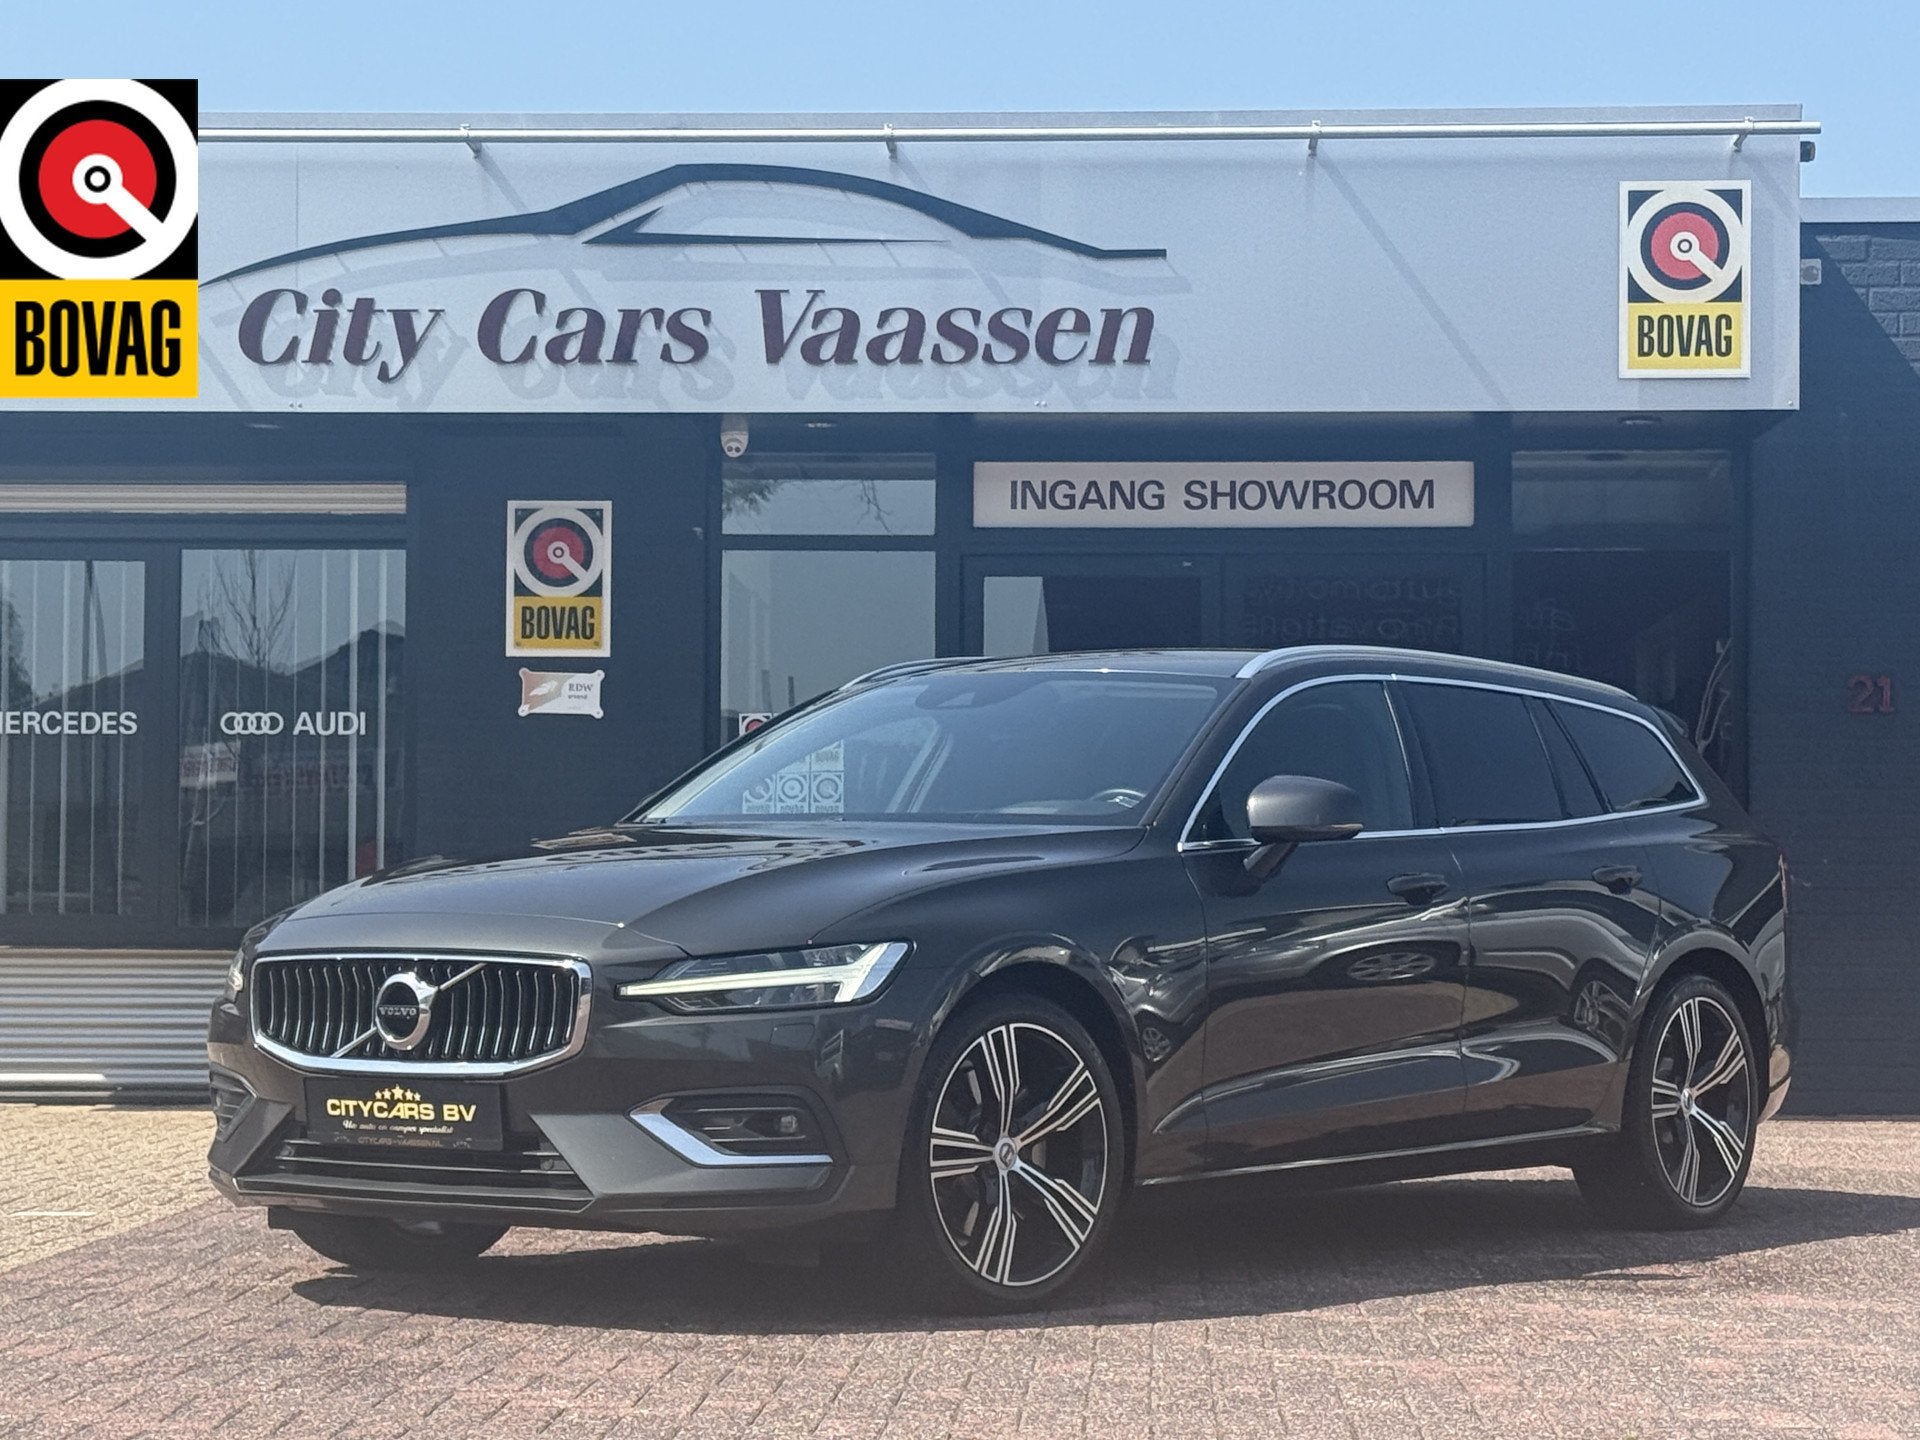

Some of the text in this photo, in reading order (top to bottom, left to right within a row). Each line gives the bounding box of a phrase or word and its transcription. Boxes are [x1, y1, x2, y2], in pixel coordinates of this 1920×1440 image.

[238, 288, 1155, 383] City Cars Vaassen
[1637, 314, 1732, 358] BOVAG
[1010, 478, 1434, 511] INGANG SHOWROOM
[520, 605, 595, 641] BOVAG
[568, 683, 593, 695] RDW
[1848, 675, 1895, 713] 21
[293, 712, 366, 735] AUDI
[379, 1007, 417, 1016] VOLVO
[326, 1099, 477, 1122] CITYCARS BV
